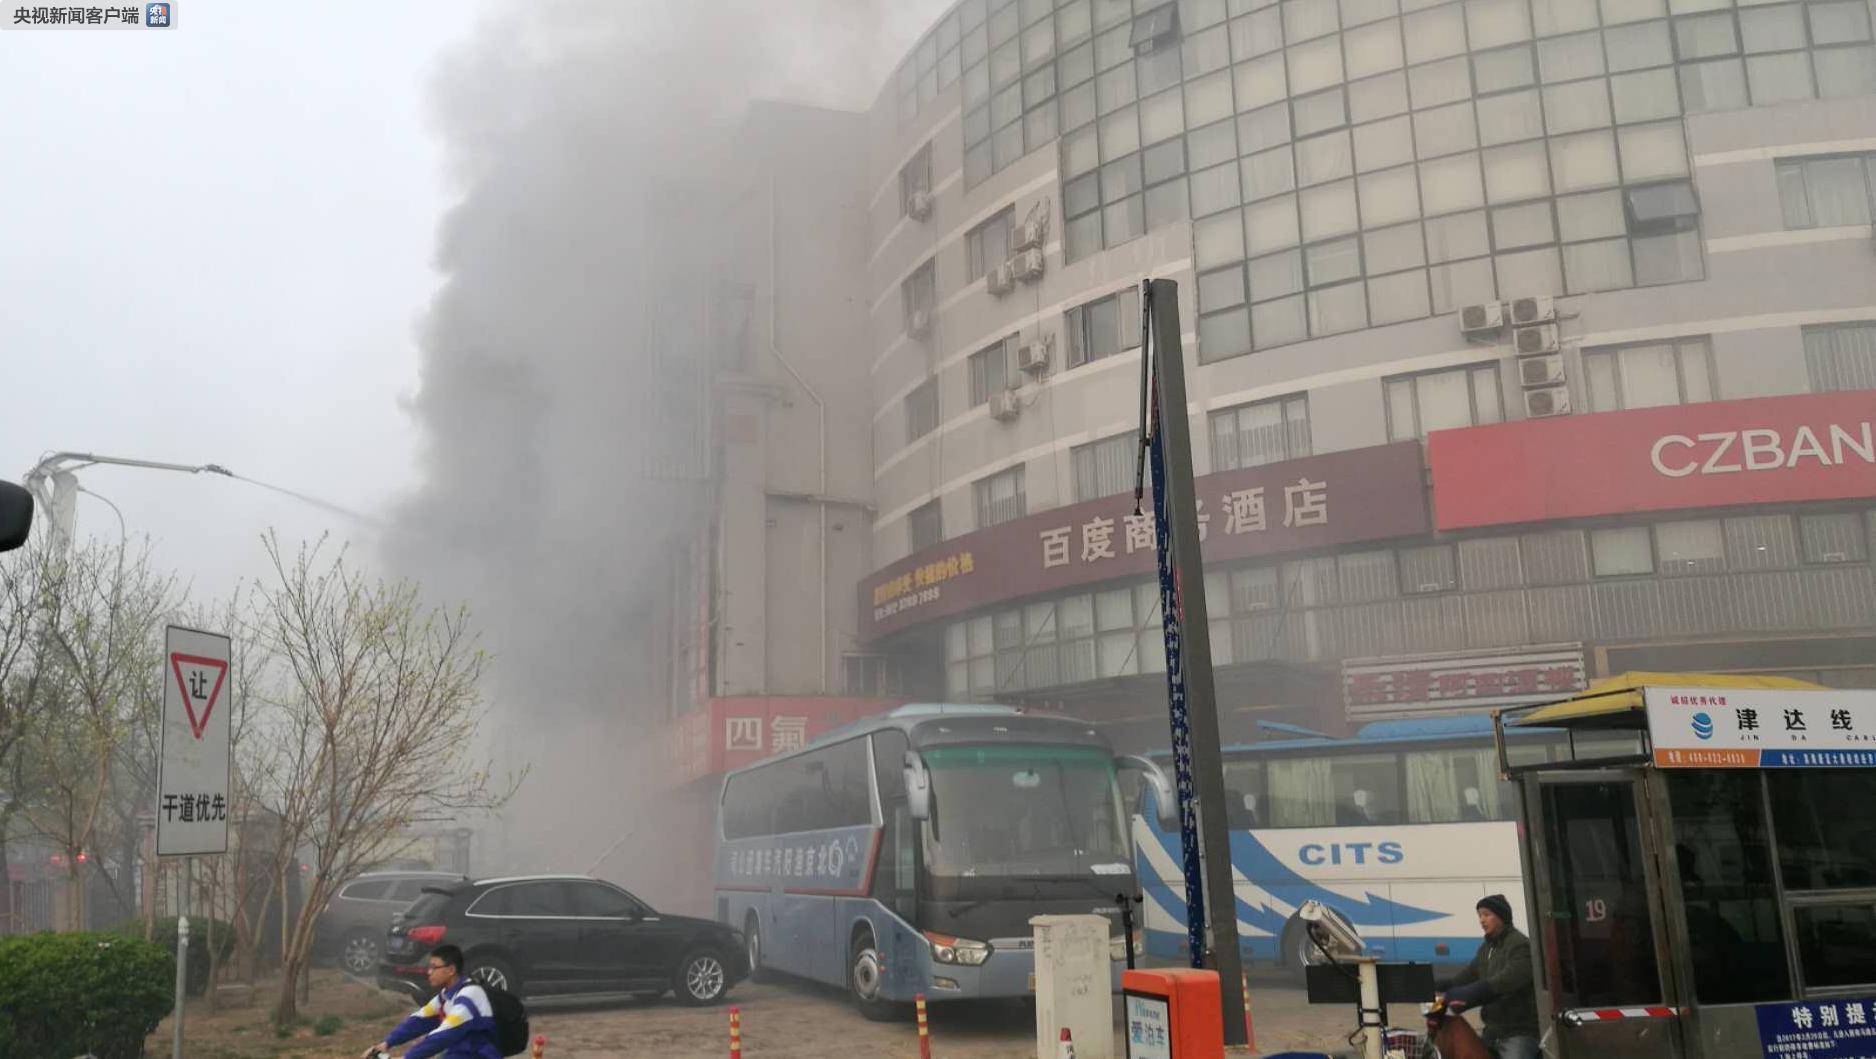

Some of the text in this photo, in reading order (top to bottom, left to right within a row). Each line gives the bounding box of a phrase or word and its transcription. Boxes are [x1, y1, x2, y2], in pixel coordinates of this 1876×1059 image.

[188, 671, 208, 700] 让
[162, 794, 227, 823] 干道优先
[1298, 841, 1404, 866] CITS
[1585, 899, 1607, 922] 19
[1791, 1002, 1876, 1029] 特别提
